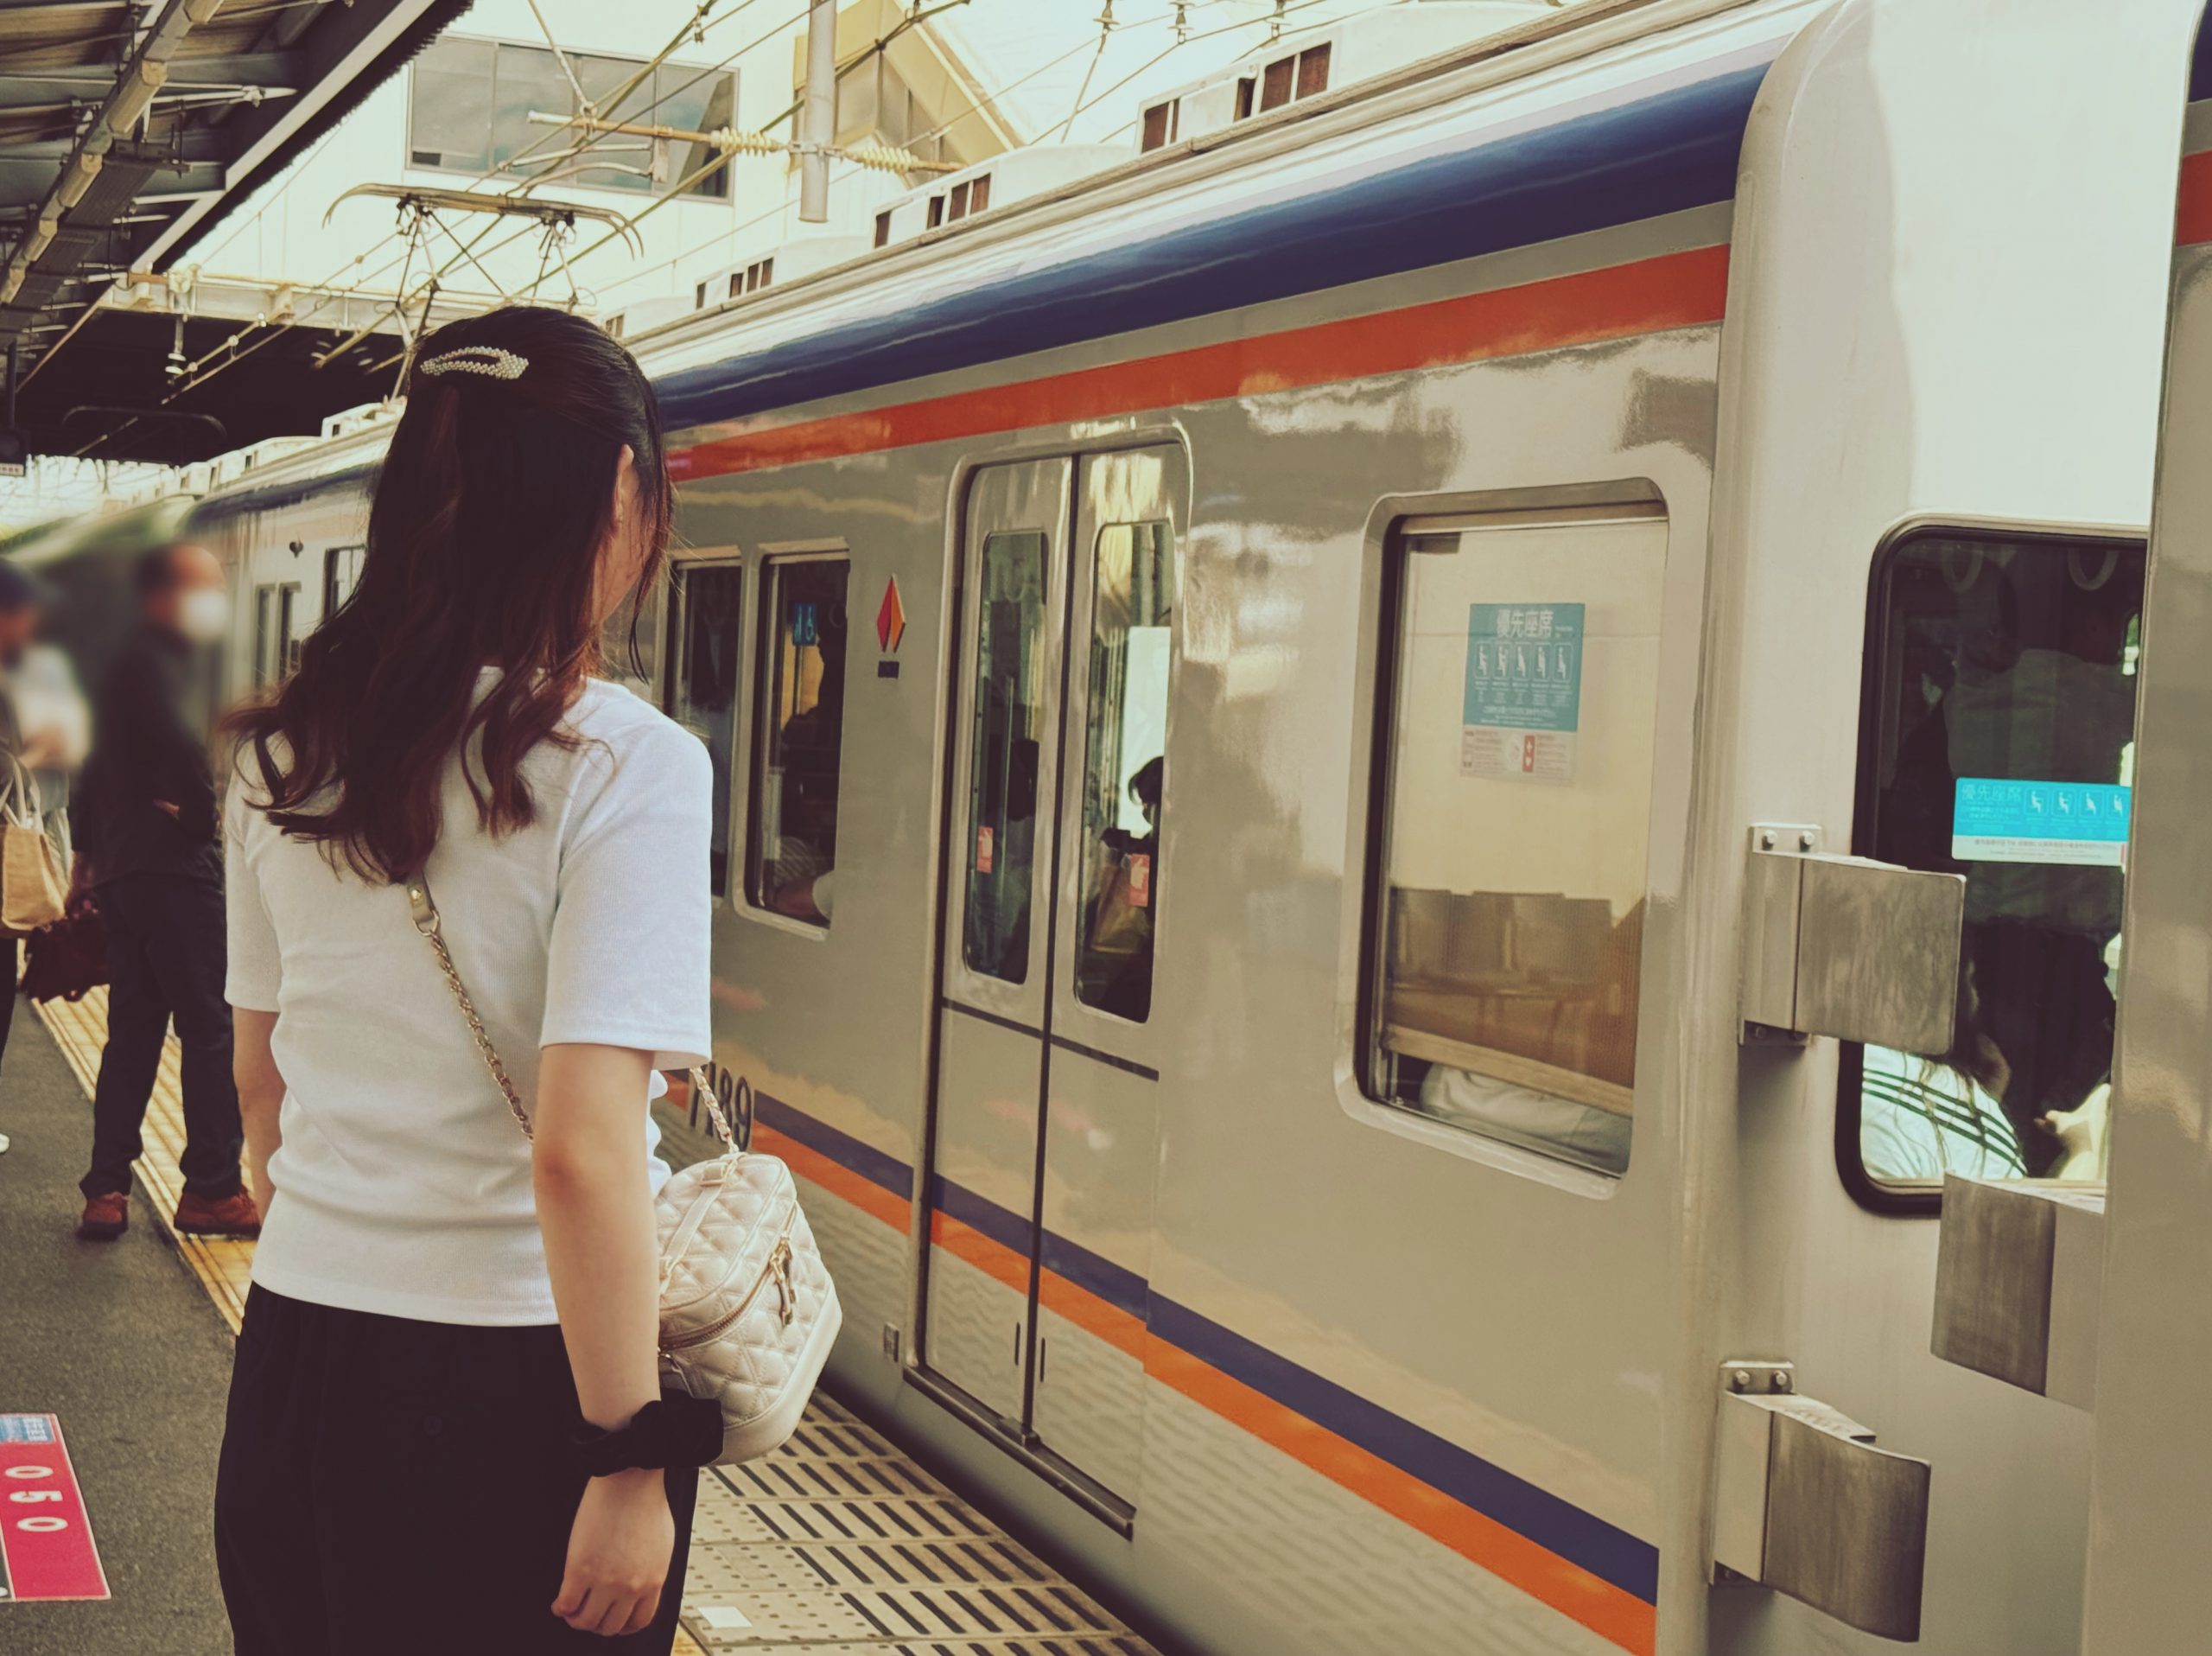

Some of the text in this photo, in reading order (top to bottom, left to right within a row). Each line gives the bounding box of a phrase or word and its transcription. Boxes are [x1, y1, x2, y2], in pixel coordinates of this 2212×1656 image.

[1497, 609, 1554, 638] 優先座席
[1961, 784, 2022, 802] 優先座席
